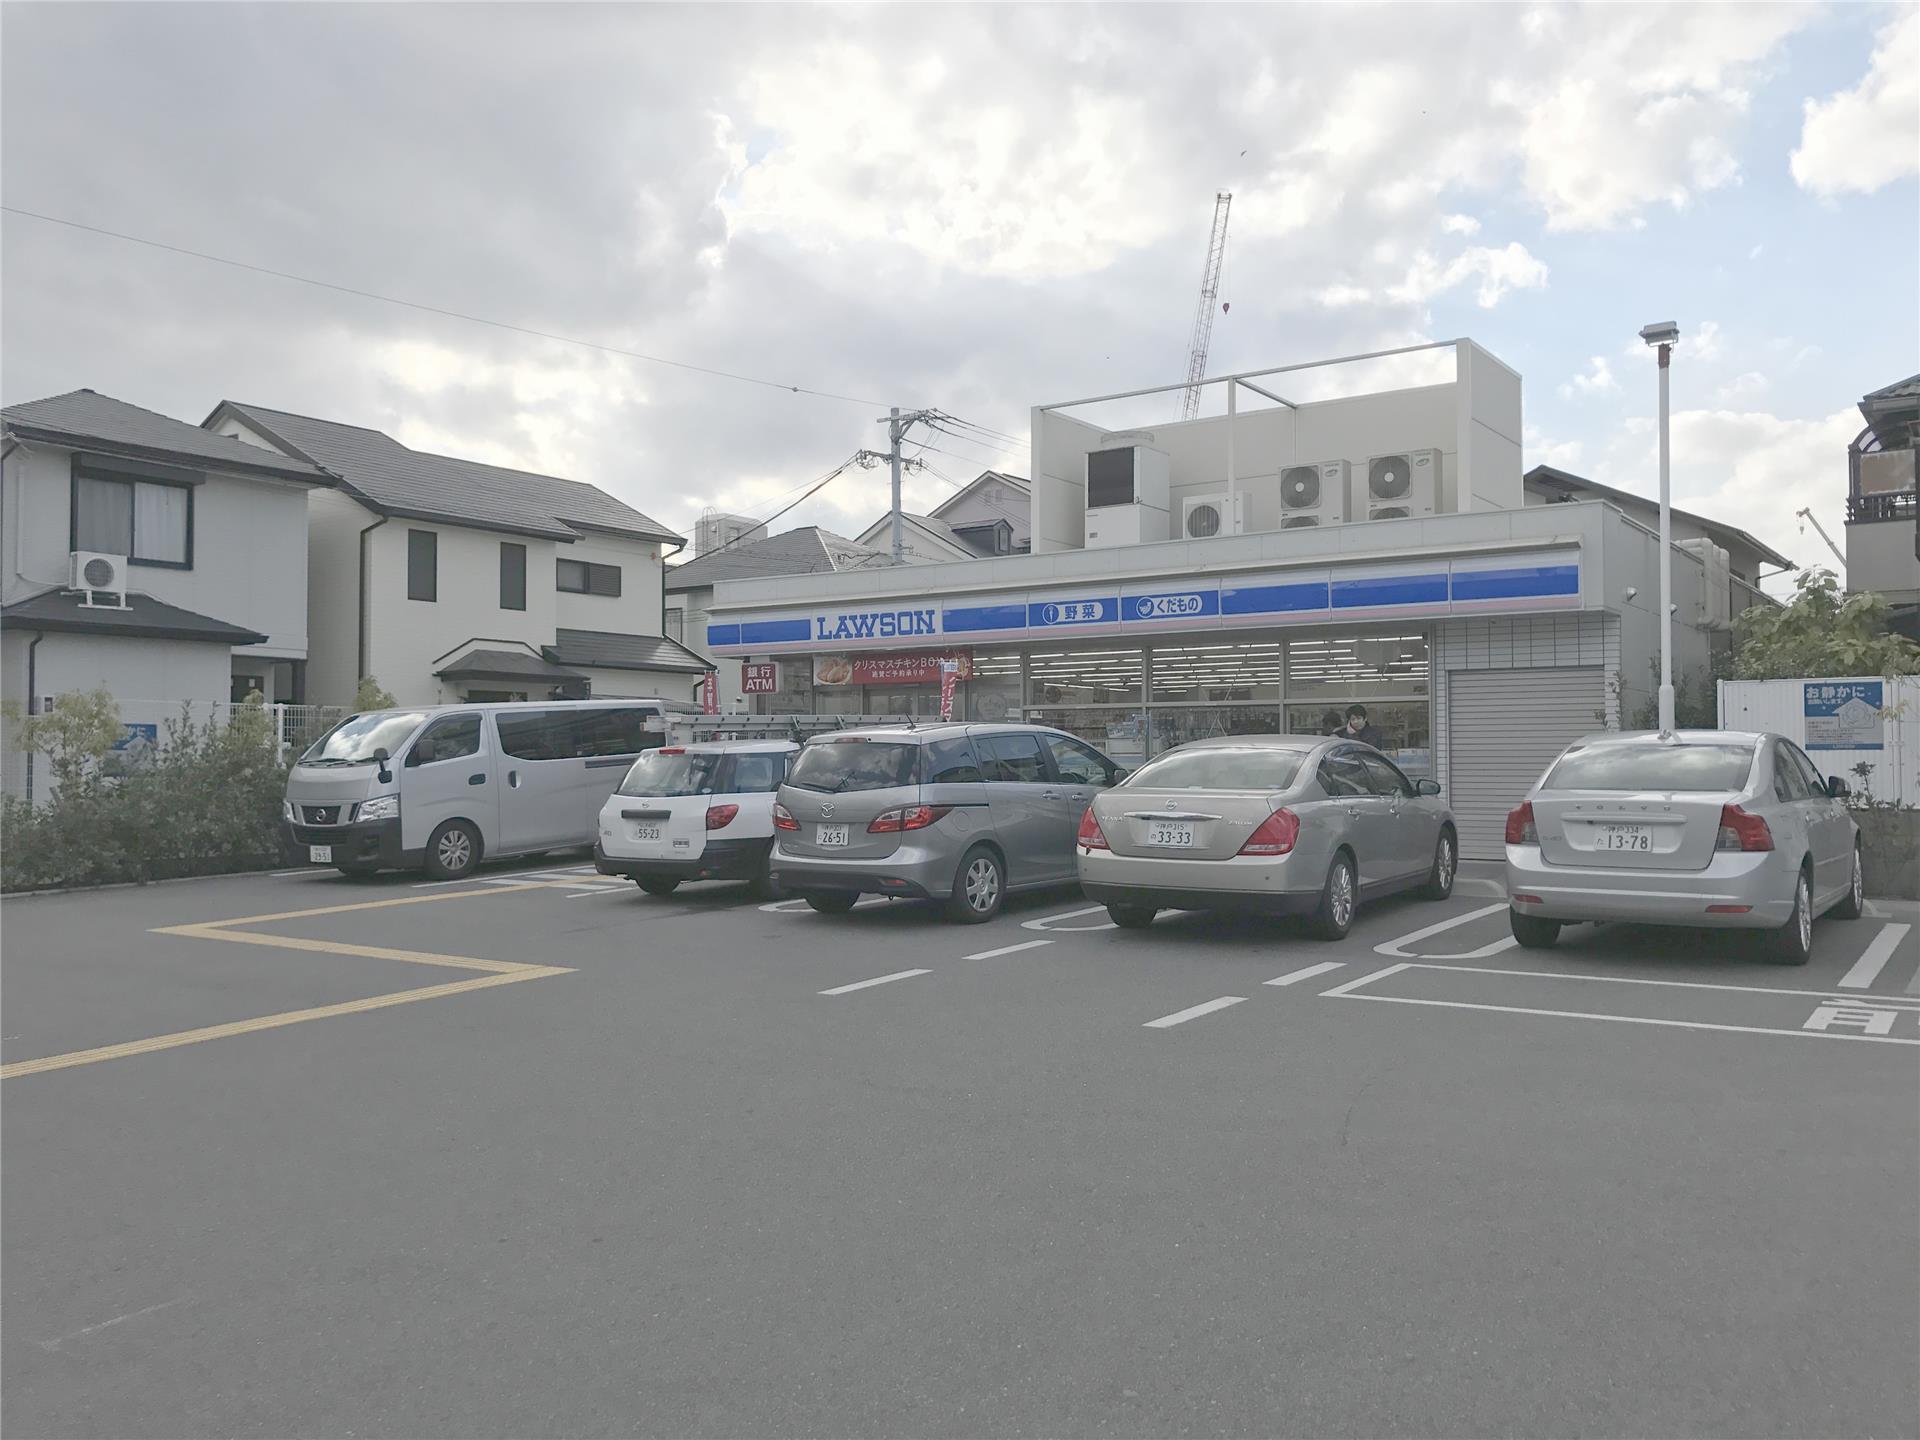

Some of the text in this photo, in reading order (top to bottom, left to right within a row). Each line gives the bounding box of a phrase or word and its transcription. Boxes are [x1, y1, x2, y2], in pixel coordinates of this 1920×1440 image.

[1156, 597, 1199, 613] くだもの
[1064, 604, 1095, 620] 野菜
[817, 609, 935, 640] LAWSON
[747, 666, 771, 678] 銀行
[746, 678, 773, 690] ATM
[1806, 686, 1865, 698] お静かに
[638, 828, 660, 839] 55-23
[823, 832, 846, 843] 26-51
[1157, 831, 1191, 844] 33-33
[1608, 835, 1649, 849] 13-78
